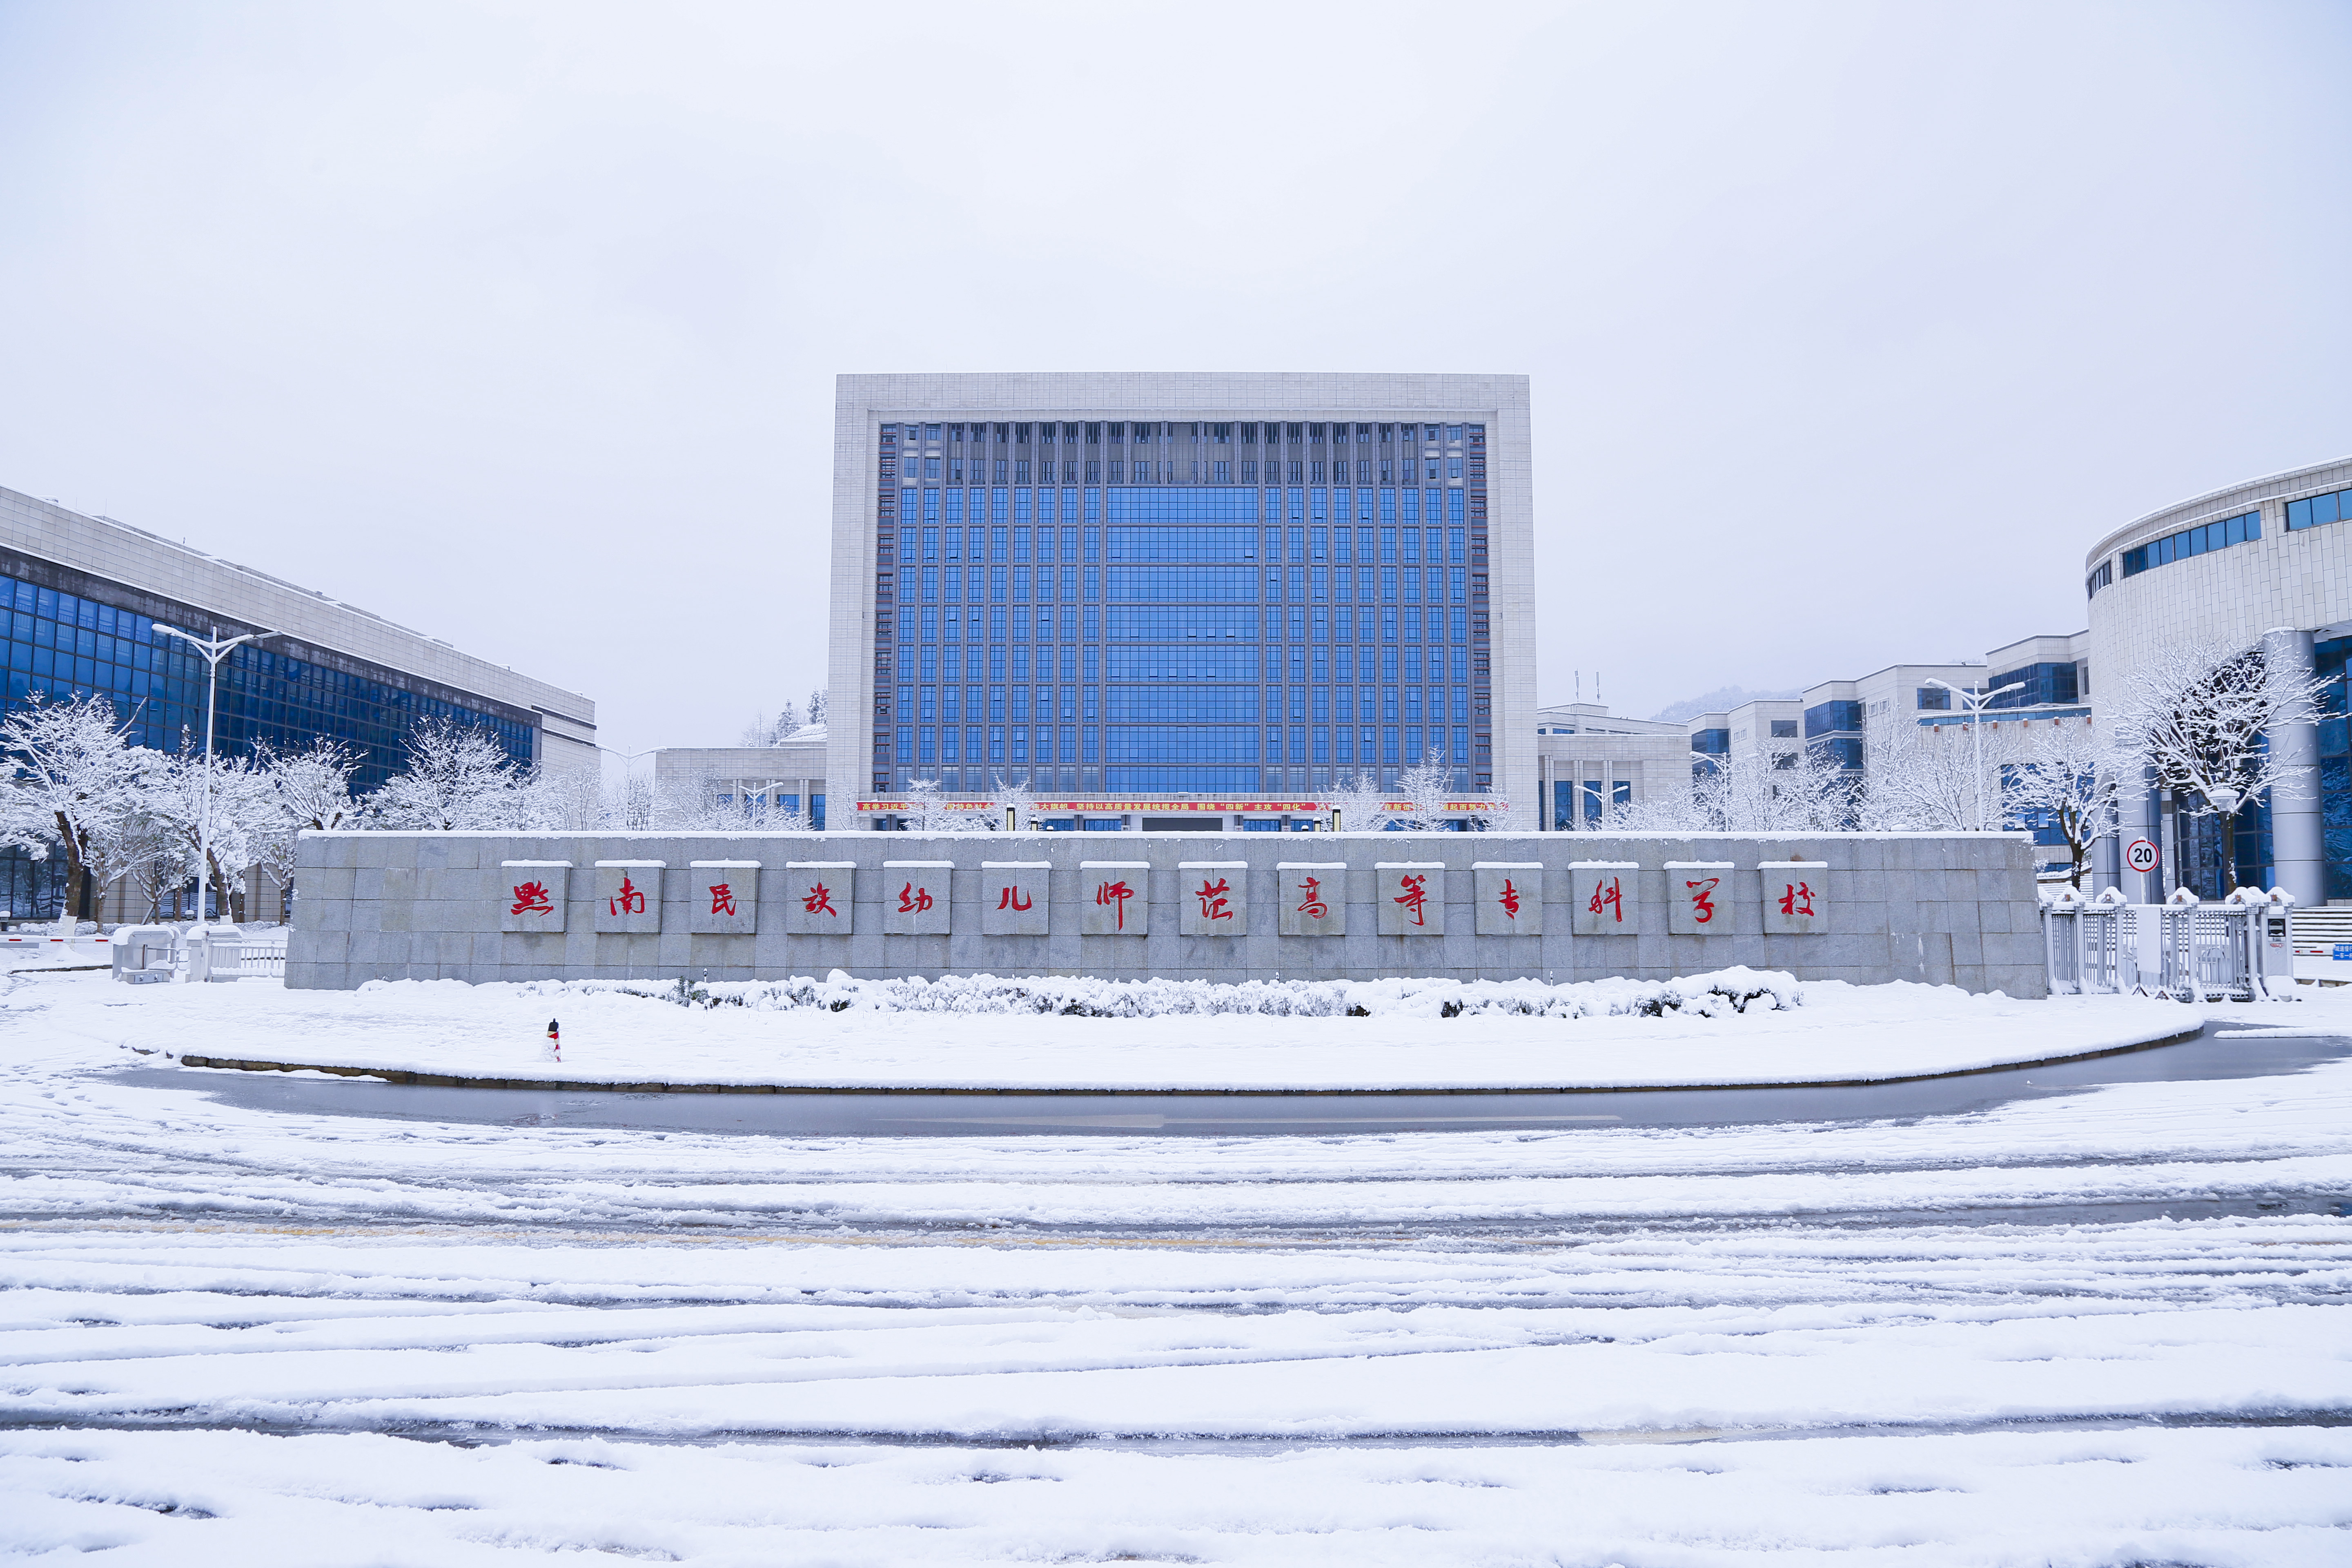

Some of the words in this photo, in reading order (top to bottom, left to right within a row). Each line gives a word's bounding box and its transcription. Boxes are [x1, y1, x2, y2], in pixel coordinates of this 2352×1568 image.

[2134, 848, 2152, 863] 20
[511, 875, 1815, 930] 黔南民族幼儿师范高等专科学校
